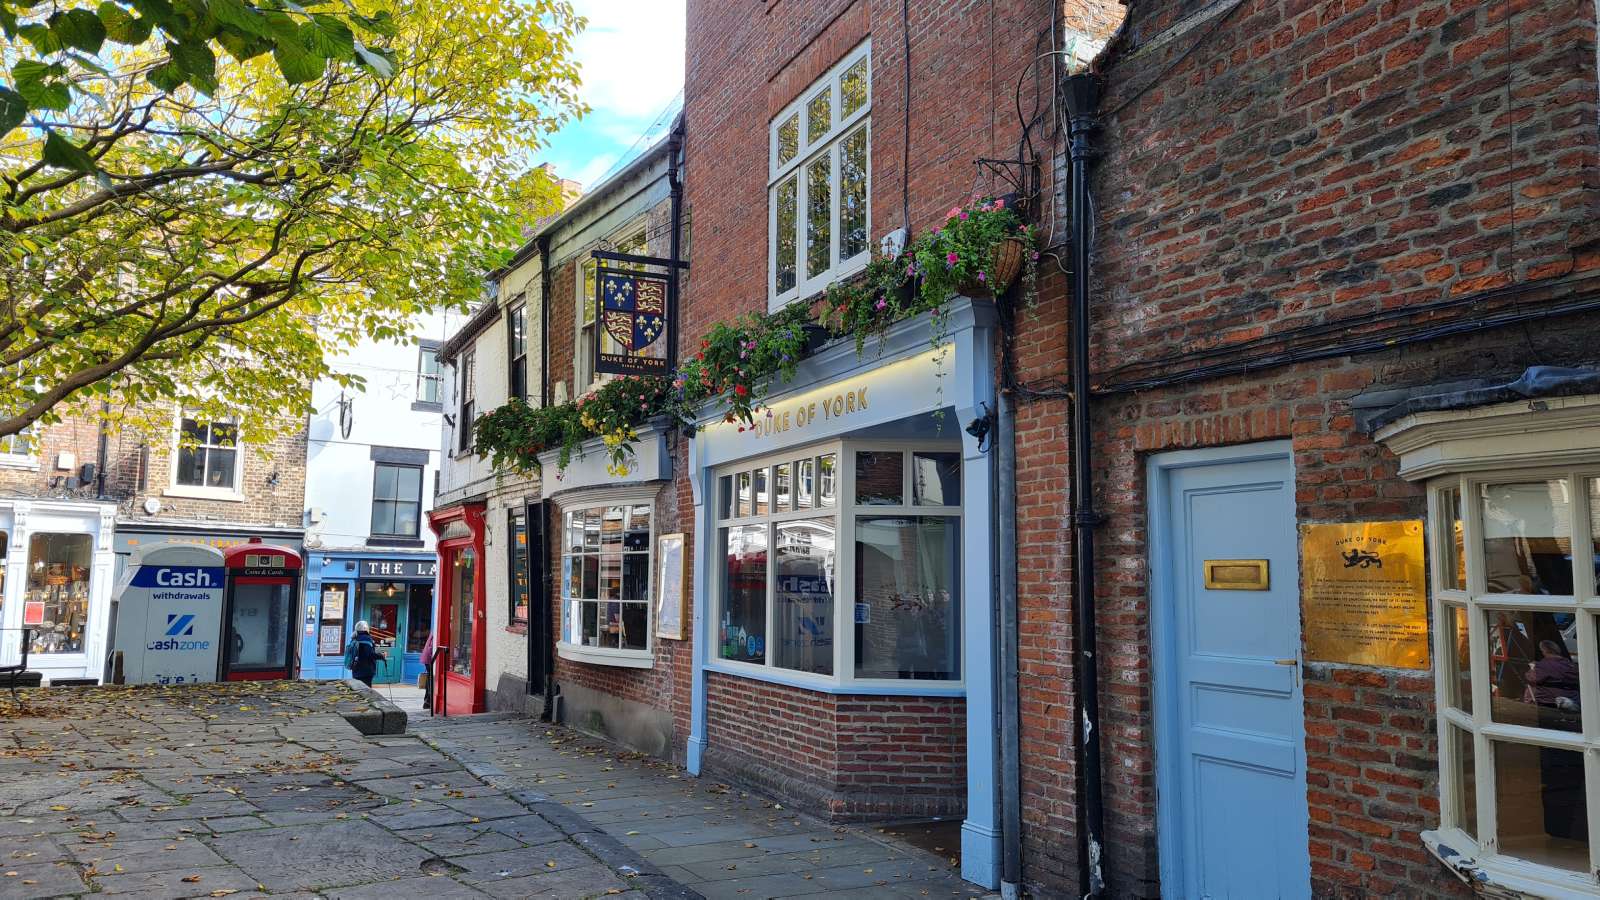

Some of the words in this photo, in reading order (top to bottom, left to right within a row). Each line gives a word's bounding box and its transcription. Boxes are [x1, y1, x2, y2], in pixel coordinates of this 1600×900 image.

[601, 355, 623, 363] DUKE
[796, 402, 816, 428] OF
[822, 386, 869, 420] YORK
[1335, 536, 1353, 546] DUKE
[1368, 537, 1387, 545] YORK
[368, 562, 403, 575] THE
[156, 568, 211, 587] Cash
[152, 591, 211, 600] withdrawals
